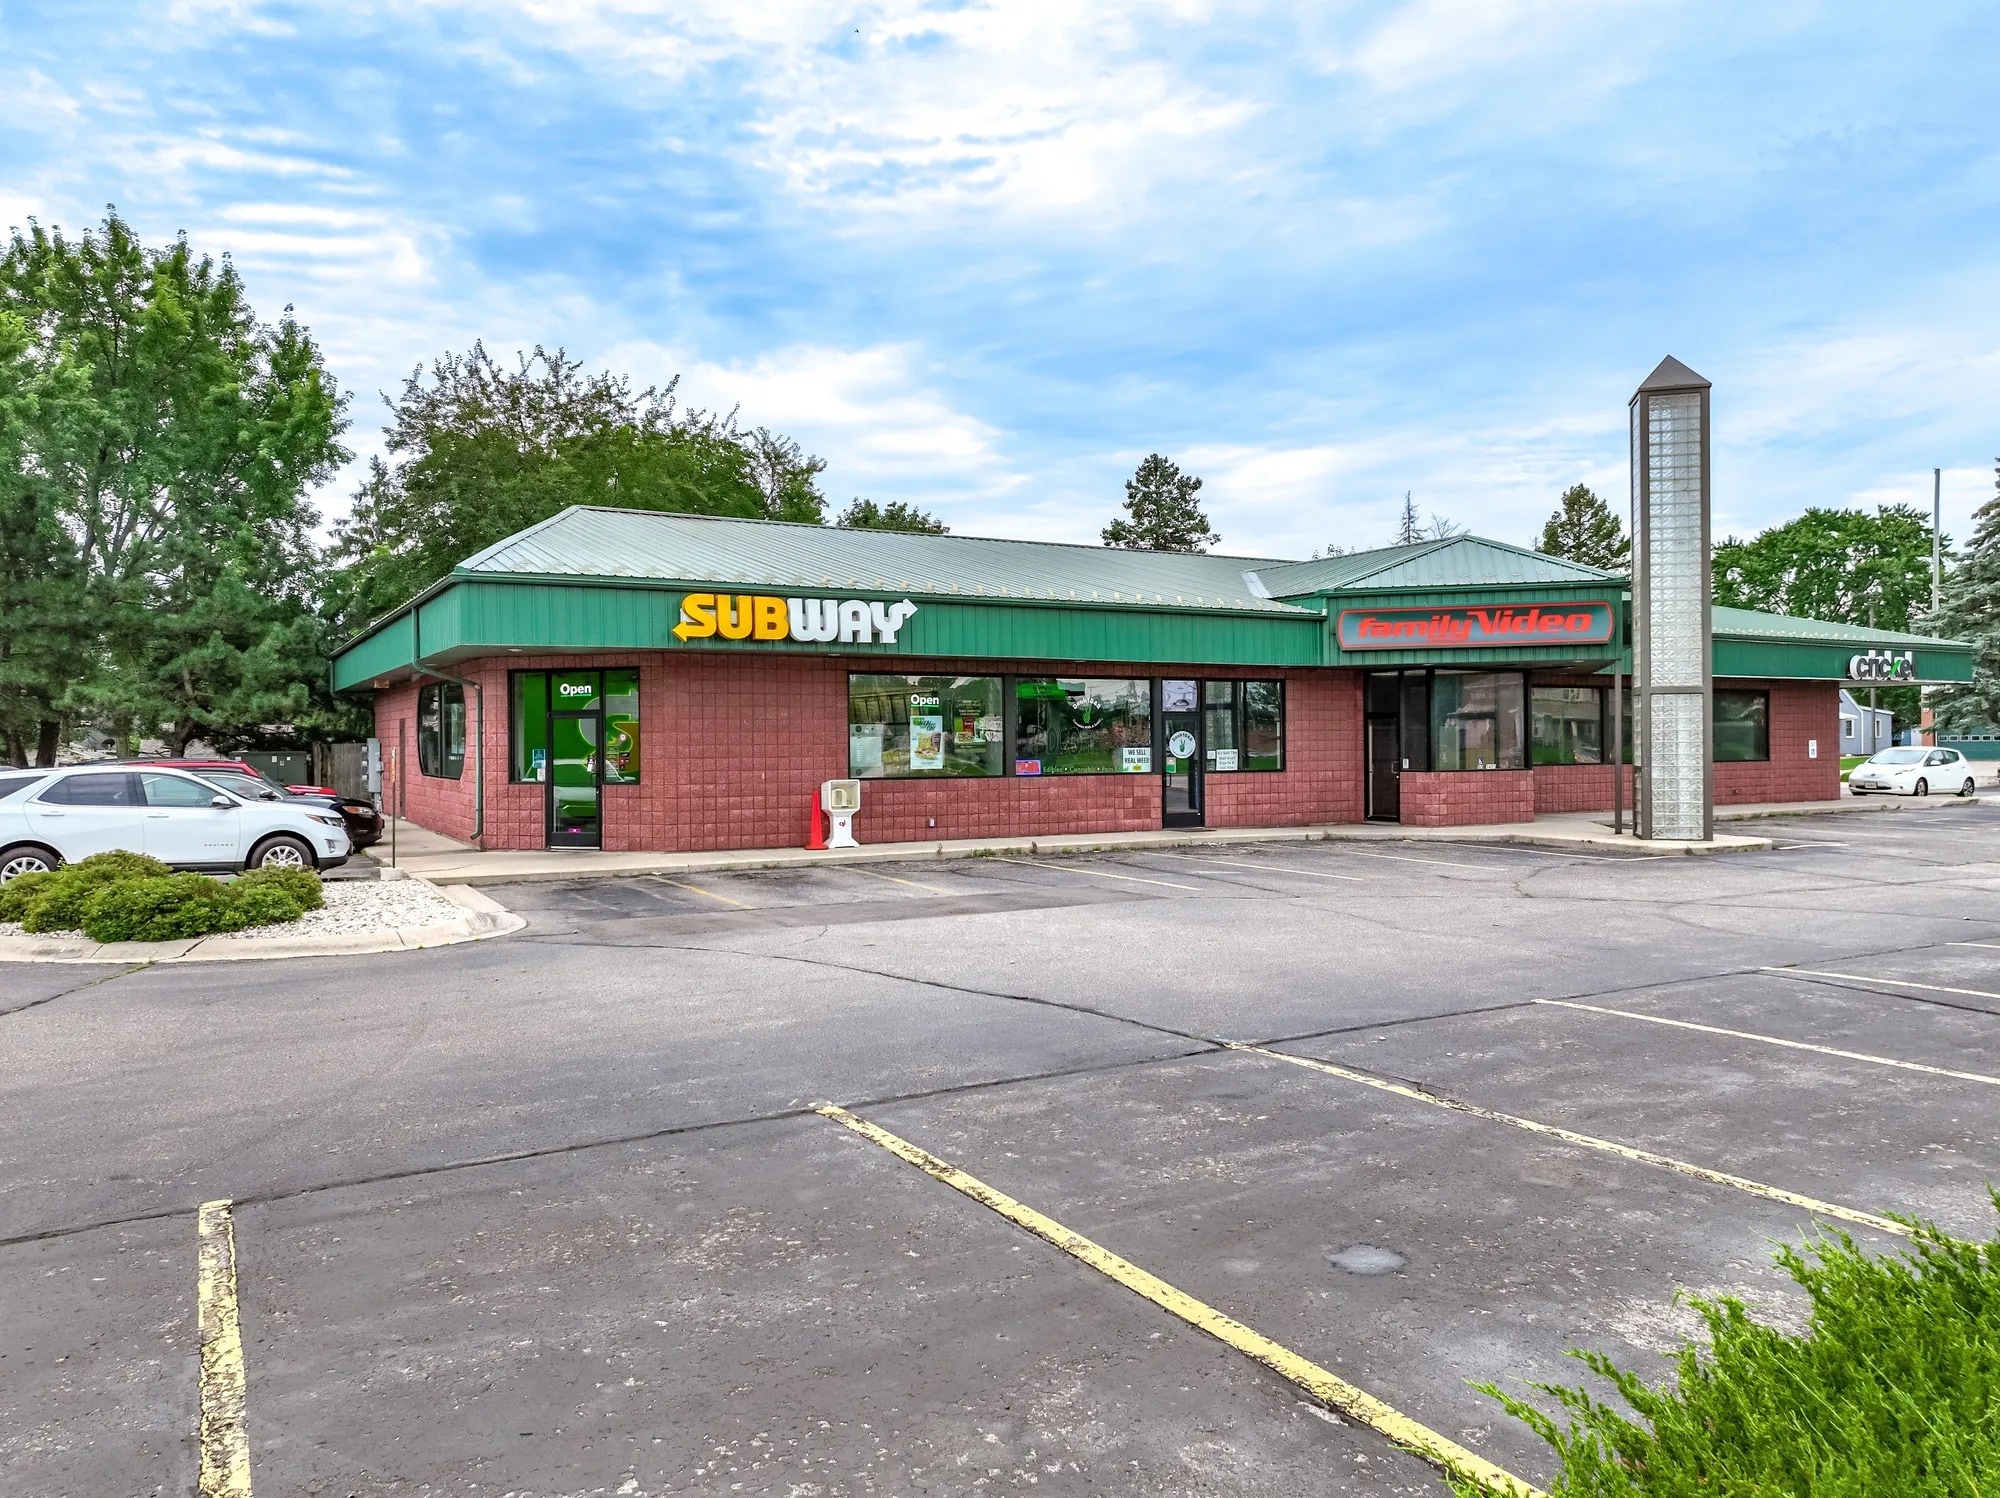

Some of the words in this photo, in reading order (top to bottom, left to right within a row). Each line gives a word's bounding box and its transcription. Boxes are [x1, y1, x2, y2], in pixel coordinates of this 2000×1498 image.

[672, 593, 918, 643] SUBWAY
[1357, 614, 1473, 644] family
[1467, 608, 1594, 635] Video
[560, 683, 592, 697] Open
[910, 694, 940, 707] Open
